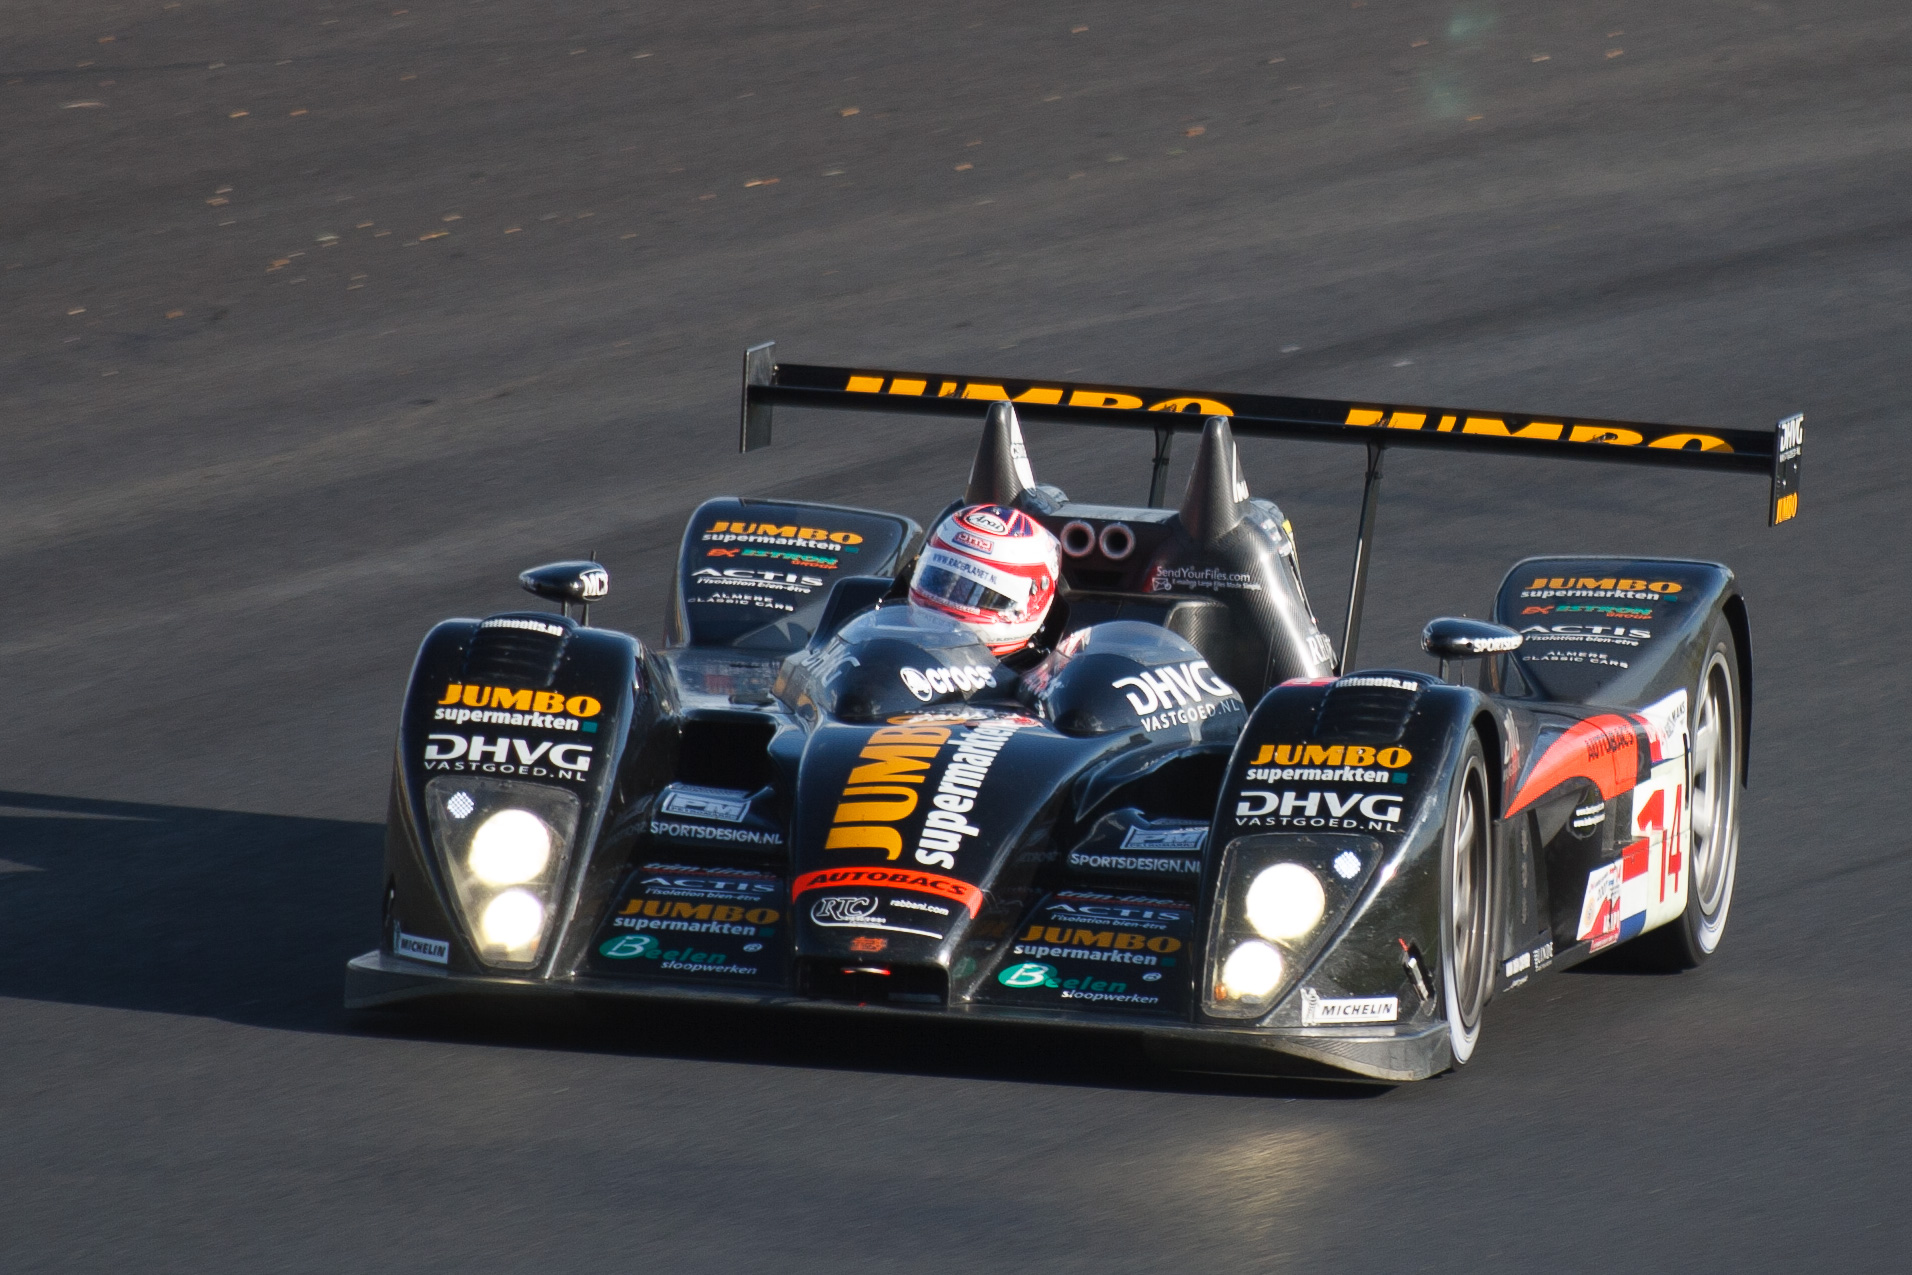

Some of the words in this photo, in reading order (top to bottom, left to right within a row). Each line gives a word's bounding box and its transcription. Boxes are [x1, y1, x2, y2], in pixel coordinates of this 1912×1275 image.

[974, 513, 1003, 530] Arai
[701, 533, 842, 552] supermarkten
[706, 521, 863, 545] JUMBO
[691, 567, 823, 587] ACTIS
[1156, 565, 1251, 583] SendYourFiles.com
[1521, 589, 1660, 601] supermarkten
[1525, 577, 1683, 593] JUMBO
[1520, 625, 1651, 638] ACTIS
[924, 664, 998, 695] crocs
[1112, 660, 1233, 715] DHVG
[438, 684, 601, 717] JUMBO
[434, 707, 579, 732] supermarkten
[1140, 702, 1241, 733] VASTGOED.NL
[424, 734, 593, 771] DHVG
[1250, 744, 1412, 768] JUMBO
[424, 761, 586, 782] VASTGOED.NL
[1246, 766, 1389, 783] supermarkten
[1236, 791, 1403, 822] DHVG
[650, 821, 783, 845] SPORTSDESIGN.NL
[1235, 817, 1396, 833] VASTGOED.NL
[641, 877, 775, 893] ACTIS
[646, 888, 704, 898] l'isolation
[807, 871, 967, 896] AUTOBACS
[618, 899, 780, 924] JUMBO
[815, 897, 870, 920] RTC
[1046, 904, 1181, 921] ACTIS
[613, 917, 756, 937] supermarkten
[1050, 914, 1111, 926] l'isolation
[401, 938, 446, 958] MICHELIN
[1020, 925, 1182, 953] JUMBO
[606, 935, 727, 965] Beelen
[1013, 944, 1158, 967] supermarkten
[661, 960, 757, 975] sloopwerken
[1005, 963, 1127, 993] Beelen
[1061, 989, 1159, 1005] sloopwerken
[1321, 1003, 1393, 1016] MICHELIN
